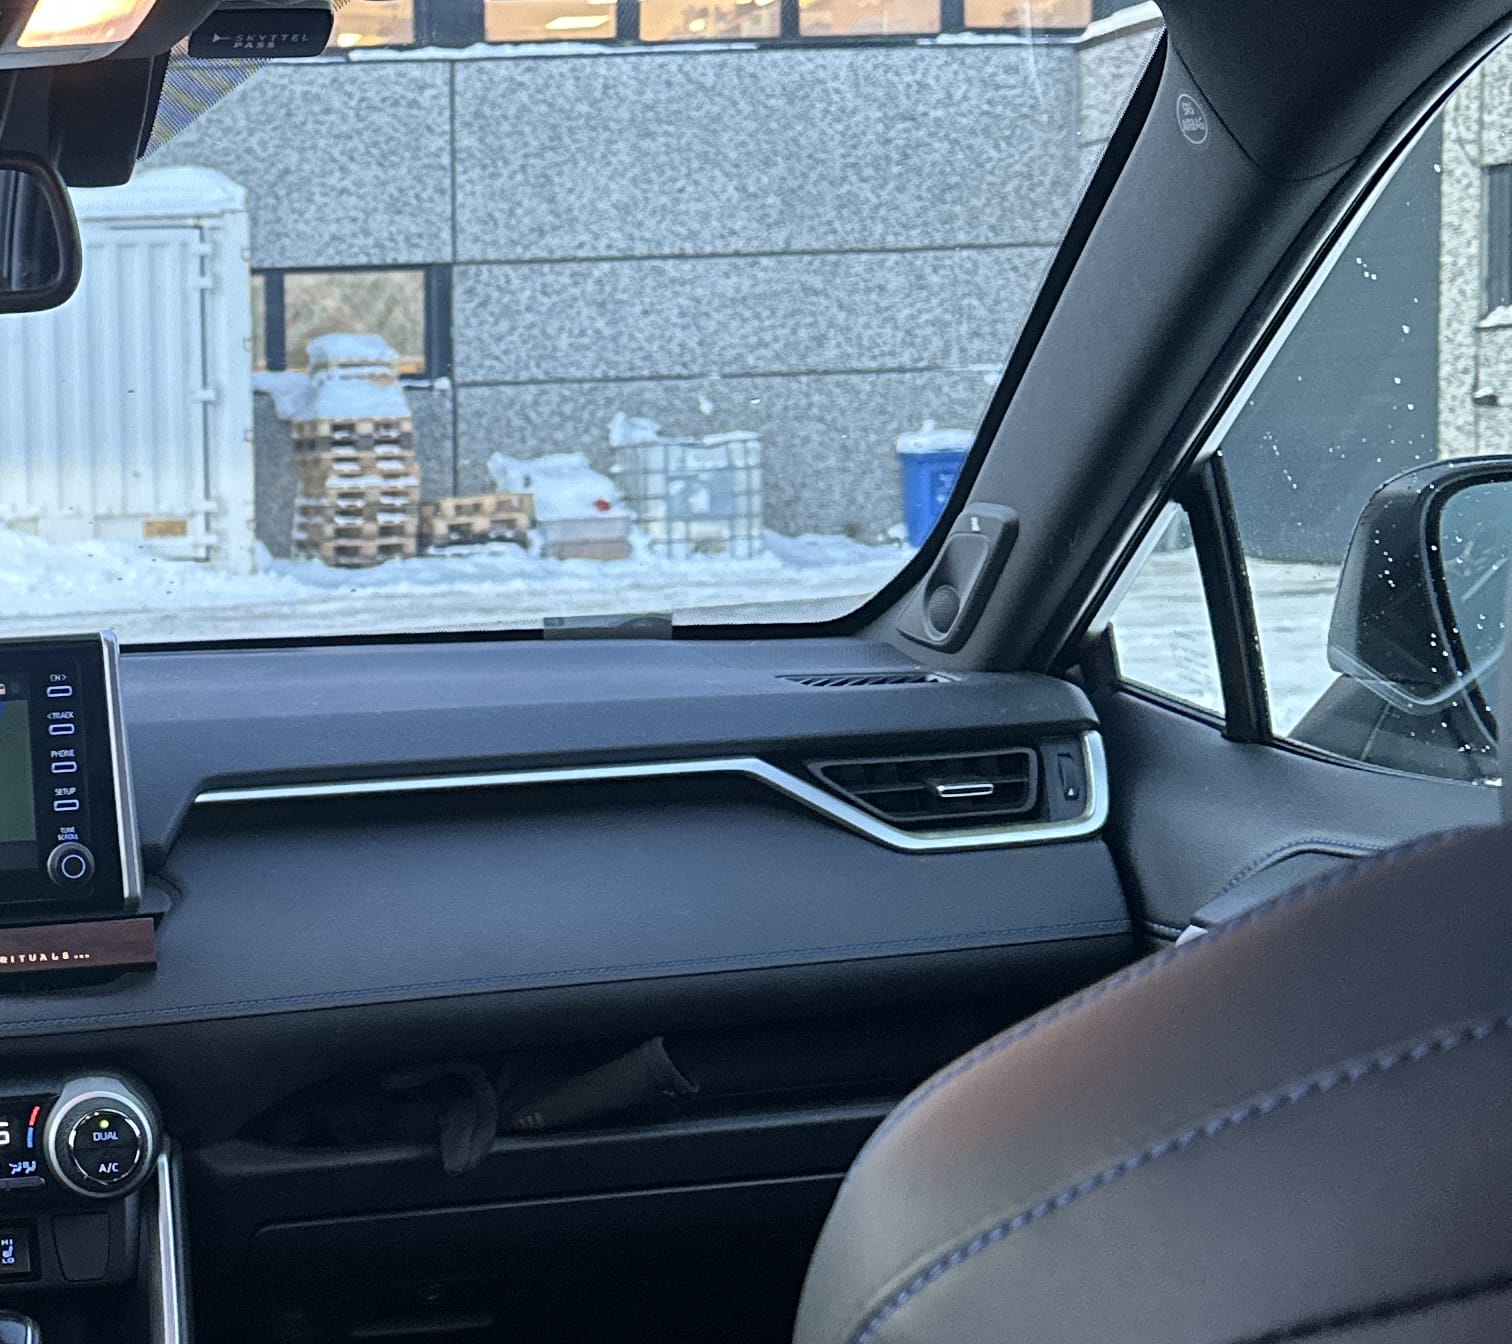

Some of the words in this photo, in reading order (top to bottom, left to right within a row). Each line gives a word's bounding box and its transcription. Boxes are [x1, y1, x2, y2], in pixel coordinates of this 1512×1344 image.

[235, 34, 309, 42] SKYTTEL
[51, 749, 75, 757] PHONE
[55, 788, 76, 796] SETUP
[93, 1131, 119, 1141] DUAL
[98, 1163, 120, 1173] A/C
[0, 1238, 13, 1246] HI
